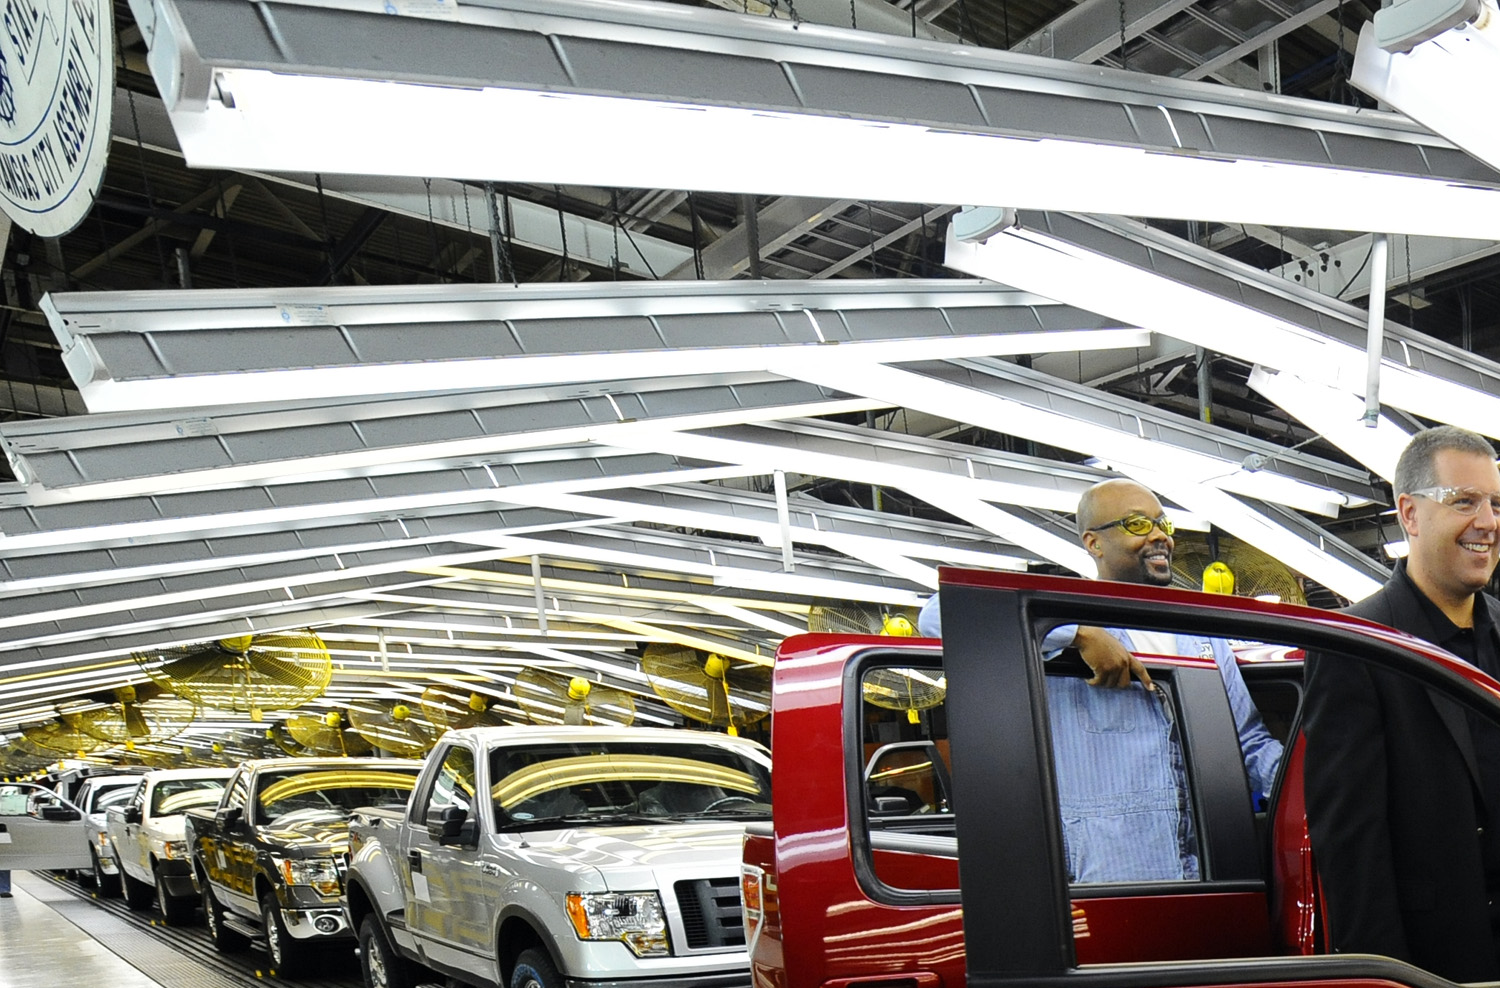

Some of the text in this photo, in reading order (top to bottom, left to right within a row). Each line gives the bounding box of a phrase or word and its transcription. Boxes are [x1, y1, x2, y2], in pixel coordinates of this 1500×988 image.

[0, 152, 40, 201] ANSAS
[32, 132, 64, 196] CITY
[53, 27, 93, 173] ASSEMBLY
